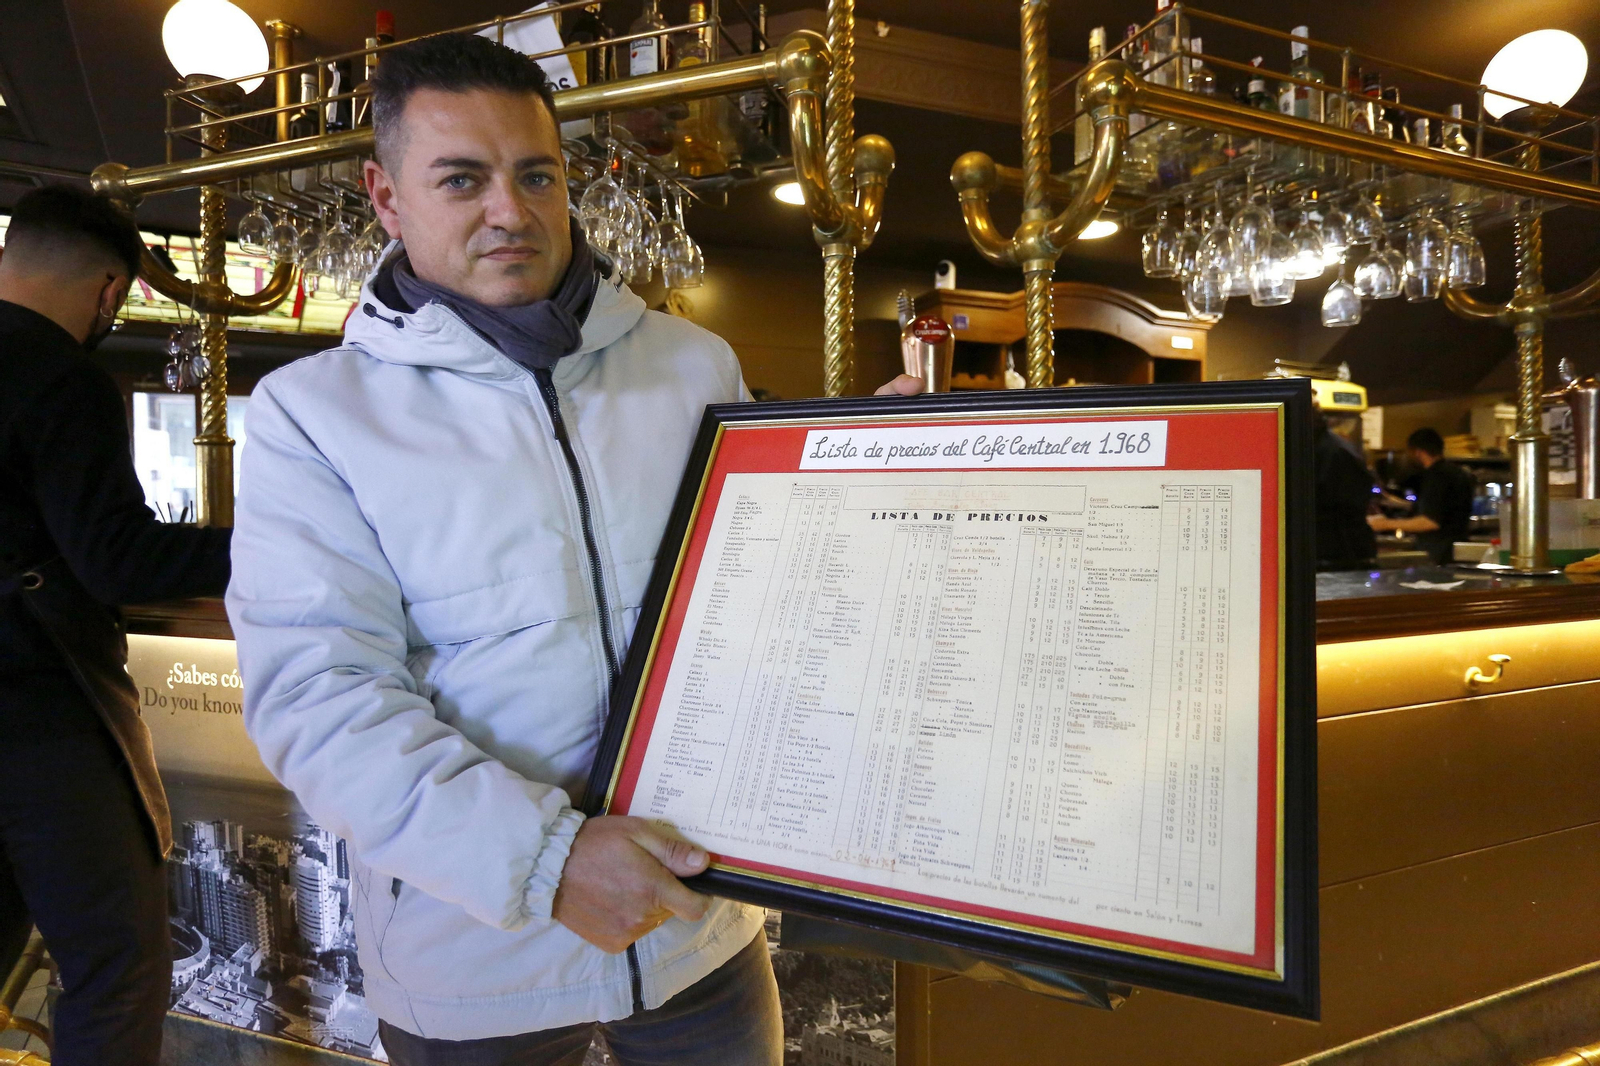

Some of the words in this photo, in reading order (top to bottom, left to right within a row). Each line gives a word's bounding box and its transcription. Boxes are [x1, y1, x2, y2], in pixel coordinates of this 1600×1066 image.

[810, 436, 857, 459] Lista
[864, 442, 882, 458] de
[885, 443, 938, 465] precios
[942, 437, 967, 456] del
[972, 435, 1010, 462] Café
[1009, 435, 1076, 455] Central
[1072, 441, 1090, 454] en
[1099, 432, 1151, 455] 1.968
[871, 512, 918, 520] LISTA
[932, 512, 955, 521] DE
[967, 513, 1048, 522] PRECIOS
[167, 663, 217, 689] ¿Sabes
[144, 687, 167, 707] Do
[172, 696, 197, 715] you
[203, 693, 244, 716] know
[911, 785, 935, 793] Chocolate
[1059, 797, 1087, 805] Sobrasada
[756, 838, 771, 847] UNA
[772, 841, 793, 851] HORA
